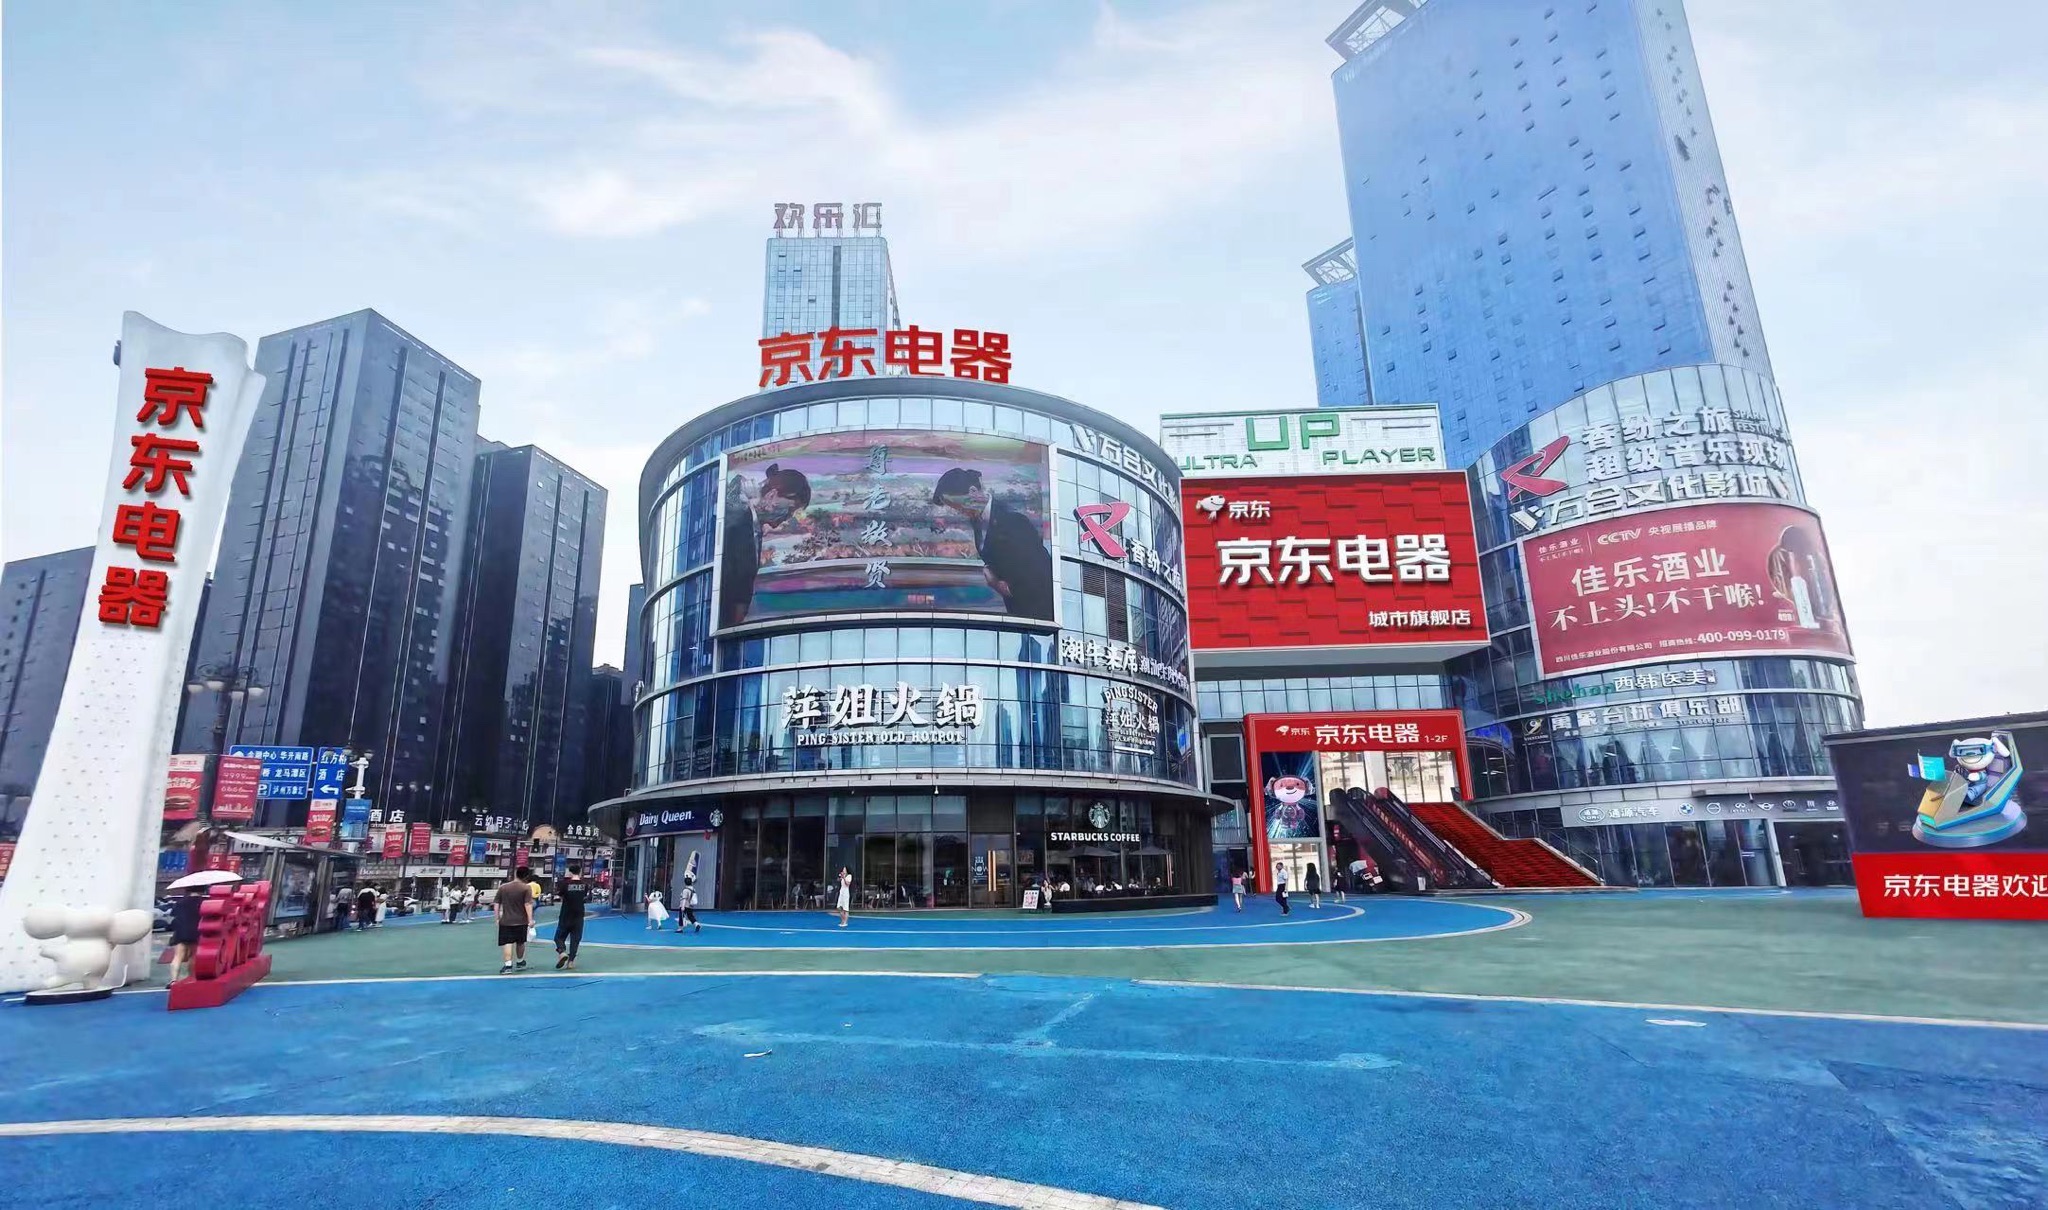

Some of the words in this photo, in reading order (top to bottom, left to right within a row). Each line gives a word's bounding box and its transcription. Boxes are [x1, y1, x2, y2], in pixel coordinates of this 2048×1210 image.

[773, 203, 882, 229] 欢乐汇
[758, 325, 1012, 387] 京东电器
[1246, 413, 1340, 451] UP
[1176, 453, 1258, 471] ULTRA
[1322, 447, 1436, 466] PLAYER
[98, 366, 213, 628] 京东电器
[1550, 469, 1774, 526] 万合文化影城
[1228, 500, 1271, 519] 京东
[1597, 528, 1642, 545] CCTV
[1217, 533, 1450, 586] 京东电器
[1571, 548, 1730, 597] 佳乐酒业
[1368, 609, 1471, 628] 城市旗舰店
[1614, 669, 1707, 692] 西韩医美
[797, 733, 827, 746] PING
[831, 732, 876, 745] SISTER
[880, 731, 905, 743] OLD
[911, 731, 963, 744] HOTPOT
[1291, 728, 1310, 736] 京东
[1314, 724, 1419, 745] 京东电器
[1424, 735, 1447, 744] 1-2F
[639, 813, 659, 826] Dairy
[661, 810, 692, 824] Queen
[1051, 832, 1108, 842] STARBUCKS
[1110, 833, 1140, 842] COFFEE
